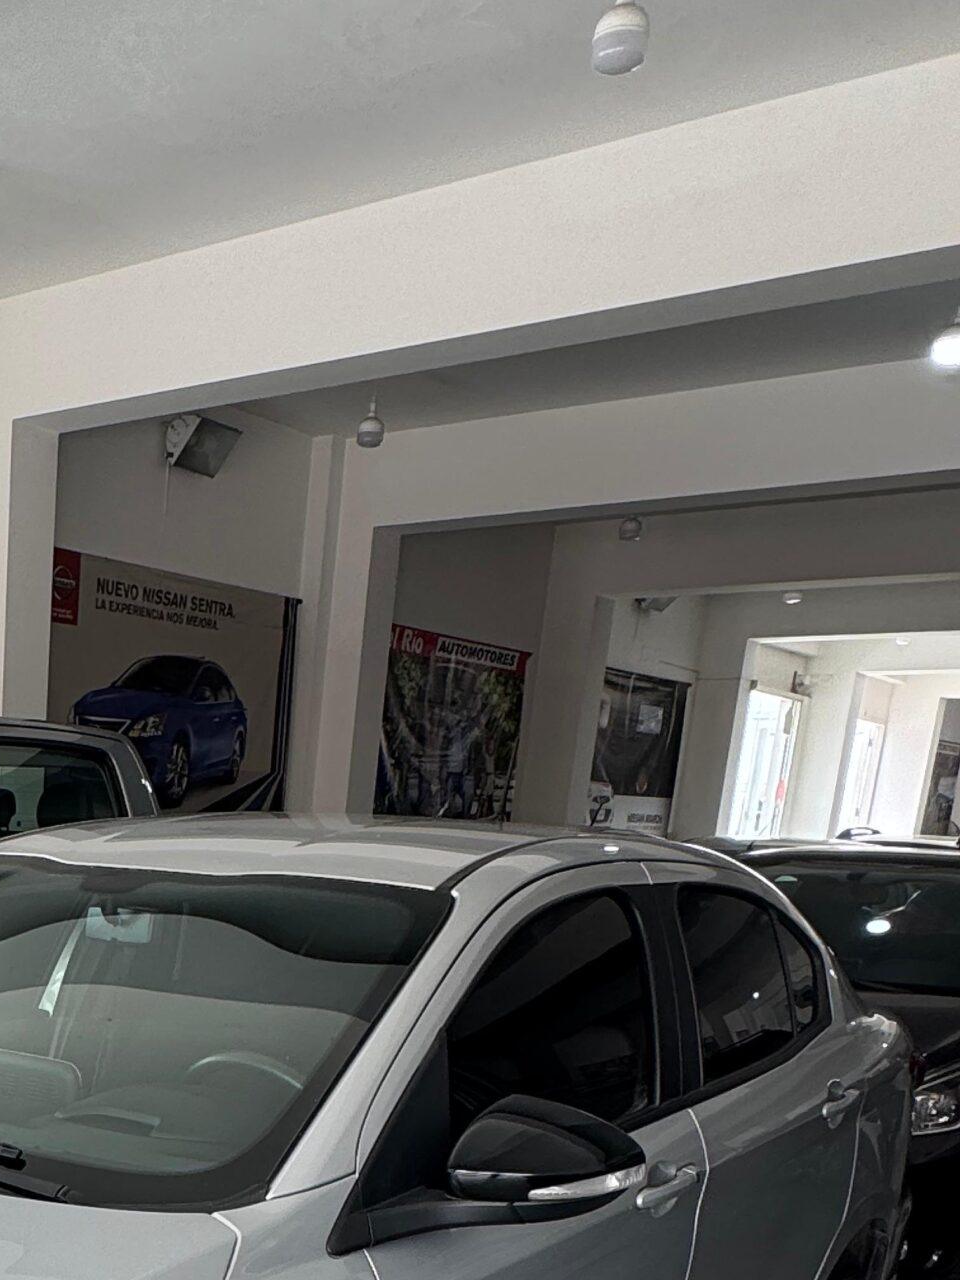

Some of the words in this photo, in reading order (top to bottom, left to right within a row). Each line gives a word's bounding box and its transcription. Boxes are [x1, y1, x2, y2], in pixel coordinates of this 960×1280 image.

[95, 597, 107, 610] LA
[109, 600, 164, 621] EXPERIENCIA
[166, 611, 184, 625] NOS
[96, 577, 139, 600] NUEVO
[142, 586, 188, 609] NISSAN
[189, 596, 236, 619] SENTRA.
[401, 628, 424, 655] Río
[437, 640, 517, 667] AUTOMOTORES
